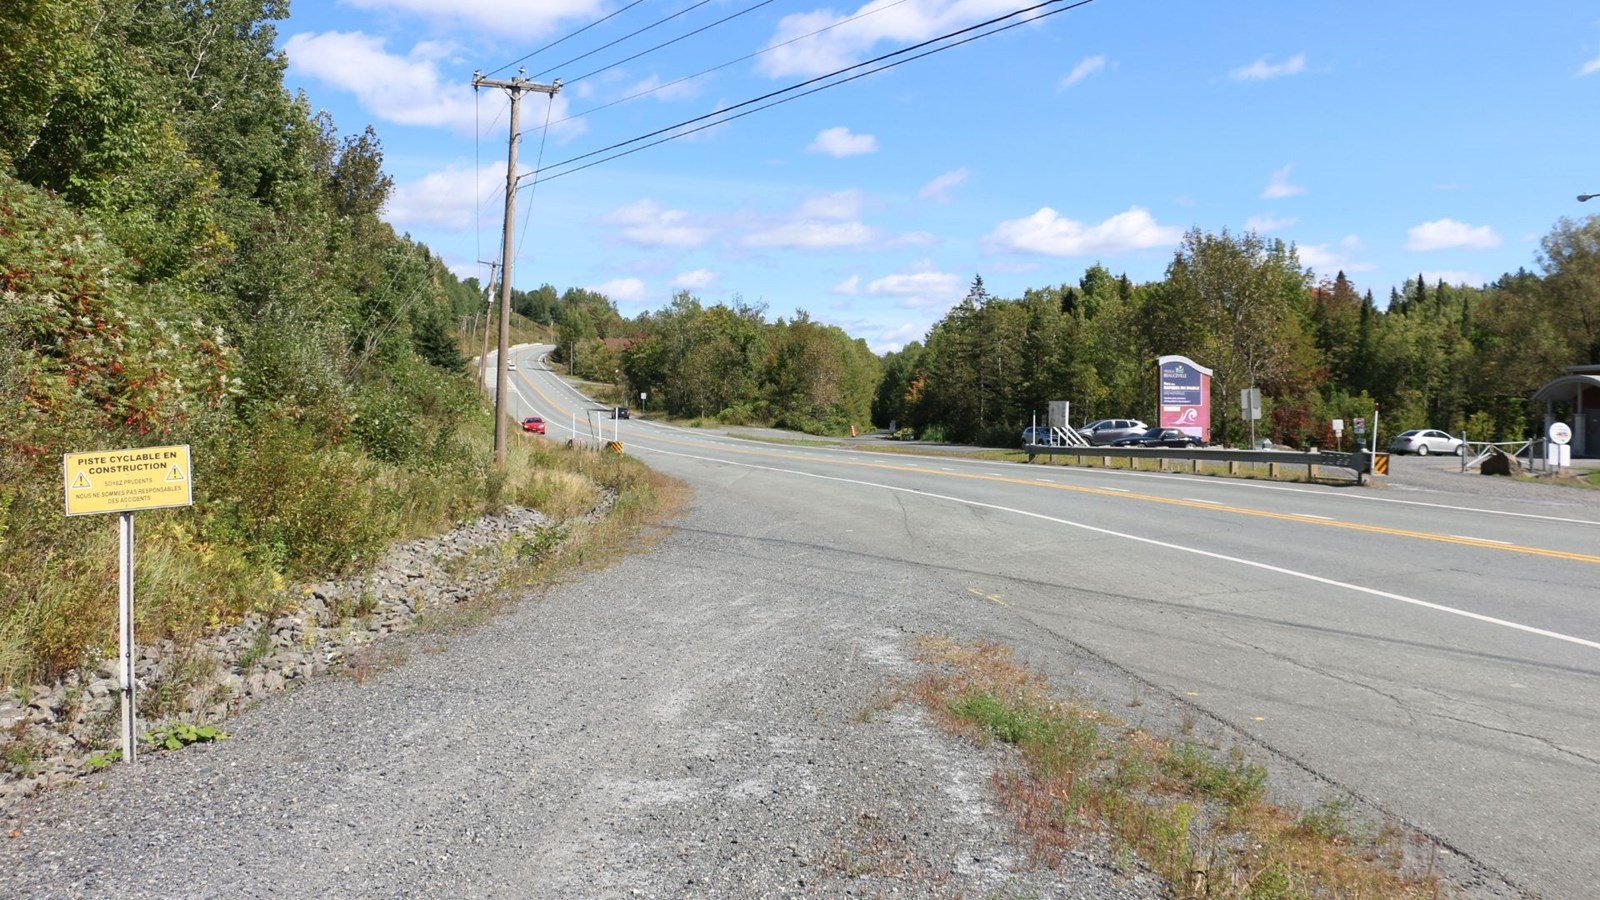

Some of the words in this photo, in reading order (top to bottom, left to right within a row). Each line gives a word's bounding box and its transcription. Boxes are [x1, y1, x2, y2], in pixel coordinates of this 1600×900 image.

[78, 456, 106, 465] PISTE
[109, 452, 160, 463] CYCLABLE
[163, 451, 177, 459] EN
[88, 462, 167, 475] CONSTRUCTION
[124, 477, 153, 485] PRUDENTS
[138, 485, 182, 494] RESPONSABLES
[120, 495, 151, 503] ACCIDENTS
